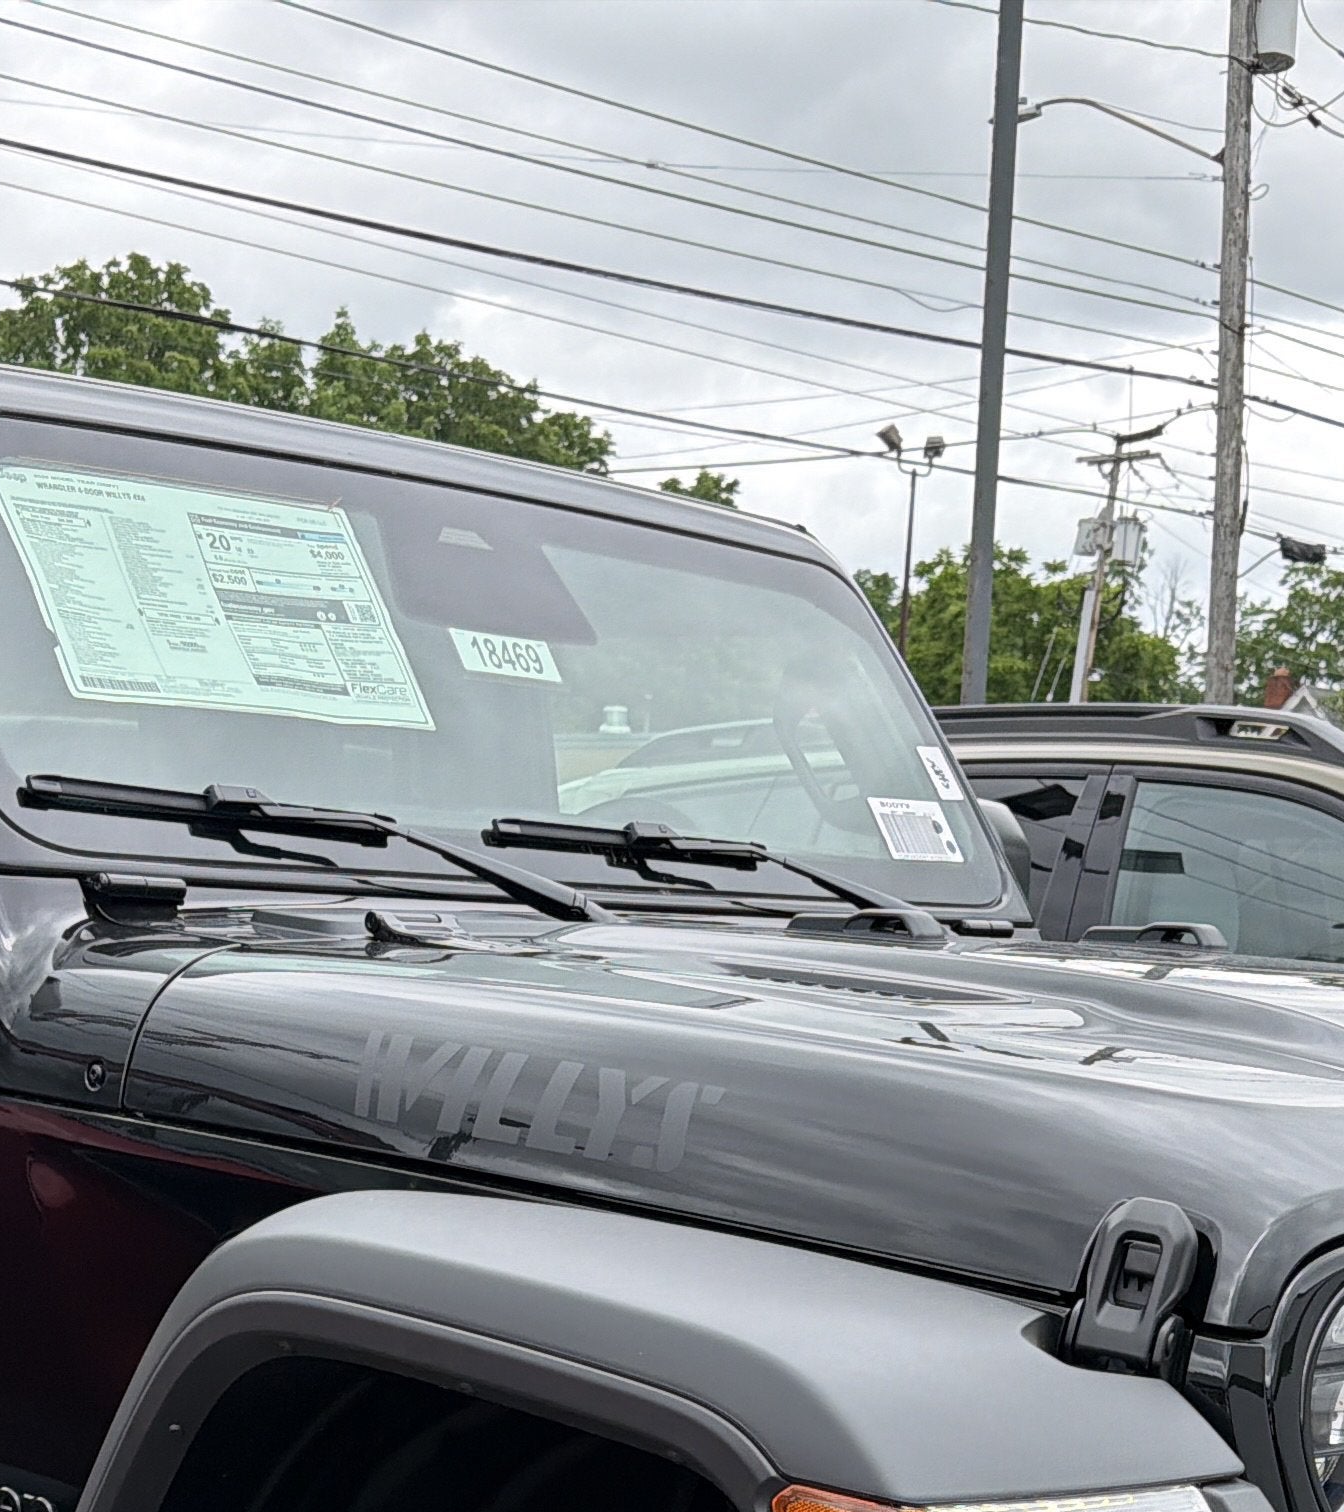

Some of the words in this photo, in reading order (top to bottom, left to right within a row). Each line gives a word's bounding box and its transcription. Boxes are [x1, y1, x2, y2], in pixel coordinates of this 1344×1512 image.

[35, 482, 76, 494] WRANGLER
[105, 490, 132, 500] WILLYS
[205, 532, 231, 551] 20
[309, 549, 345, 561] $4,000
[212, 573, 248, 586] $2,500
[471, 636, 544, 675] 18469
[351, 683, 407, 696] FlexCare
[355, 1030, 727, 1173] WILLYS
